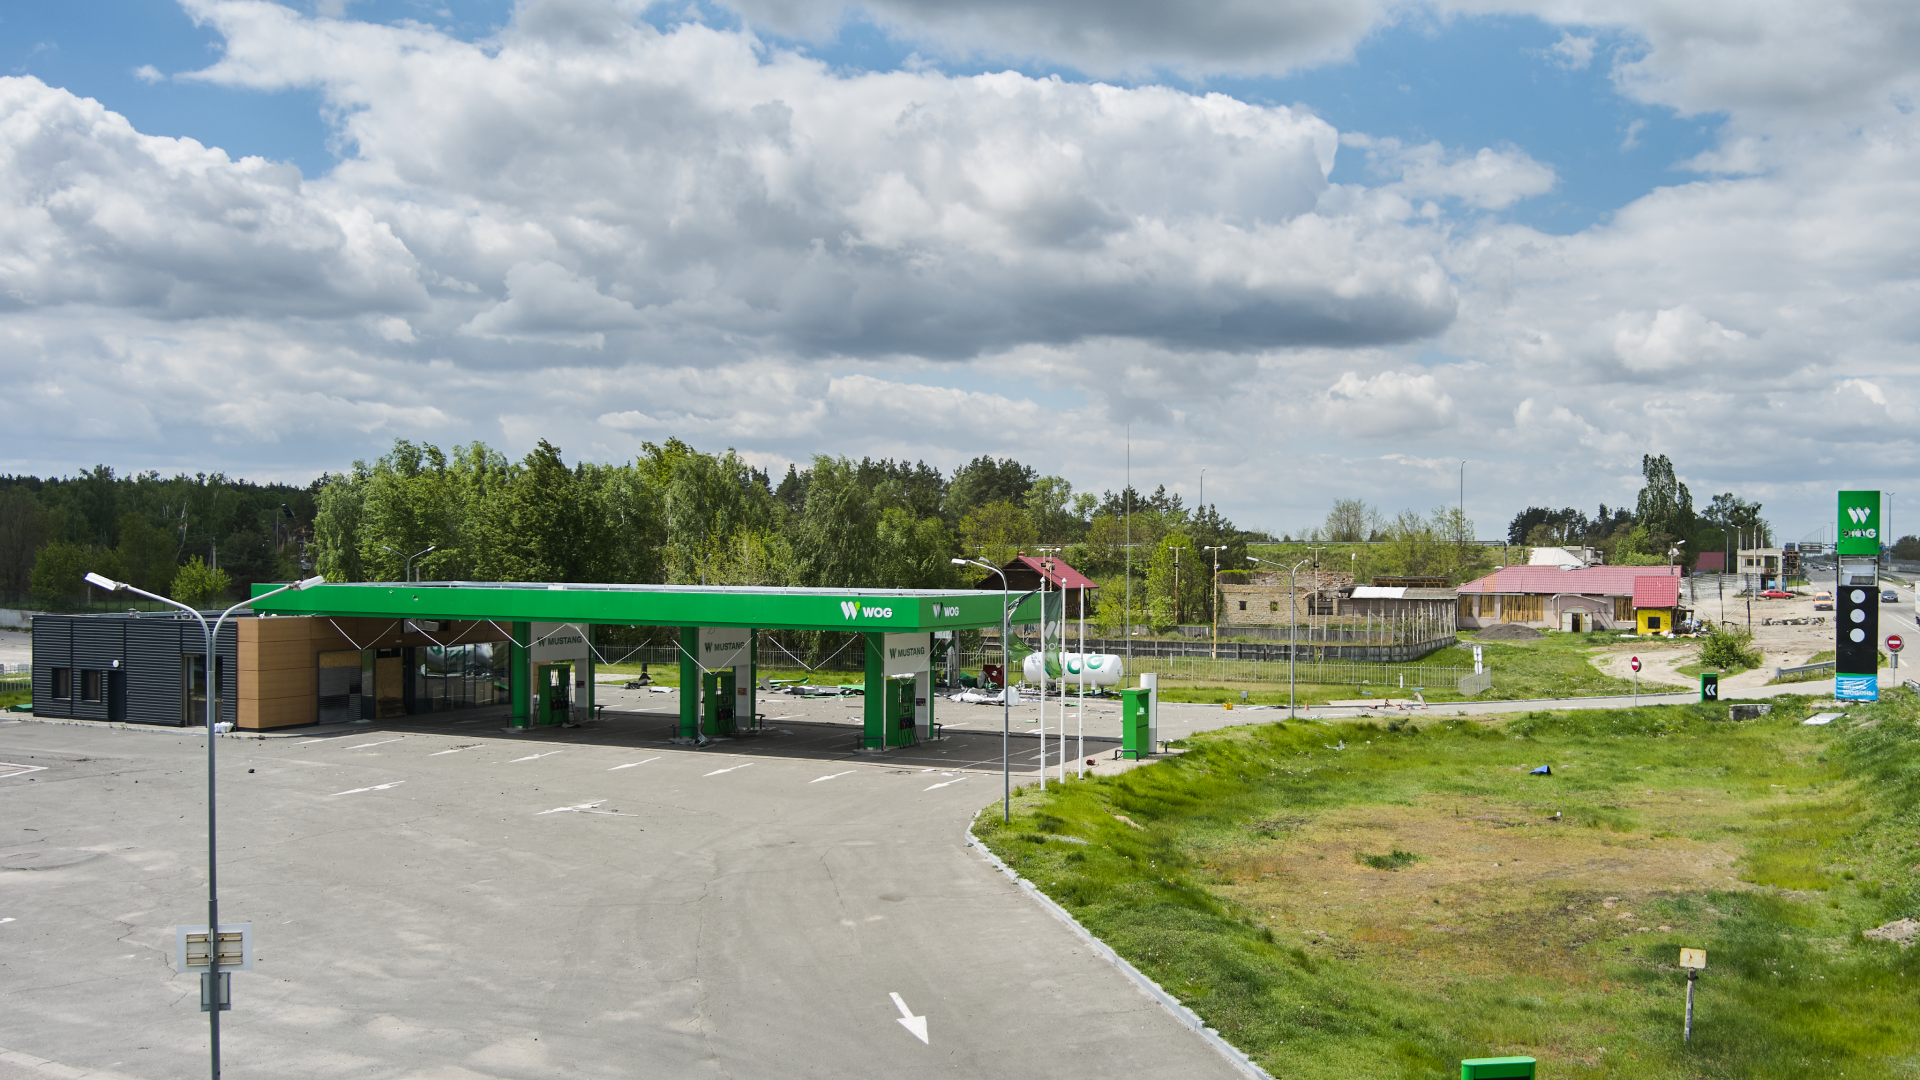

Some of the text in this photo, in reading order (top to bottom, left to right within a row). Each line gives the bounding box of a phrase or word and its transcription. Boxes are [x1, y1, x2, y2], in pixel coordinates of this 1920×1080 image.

[862, 607, 893, 618] WOG
[944, 606, 960, 617] WOG
[548, 636, 582, 645] MUSTANG
[714, 642, 745, 651] MUSTANG
[898, 646, 925, 657] MUSTANG
